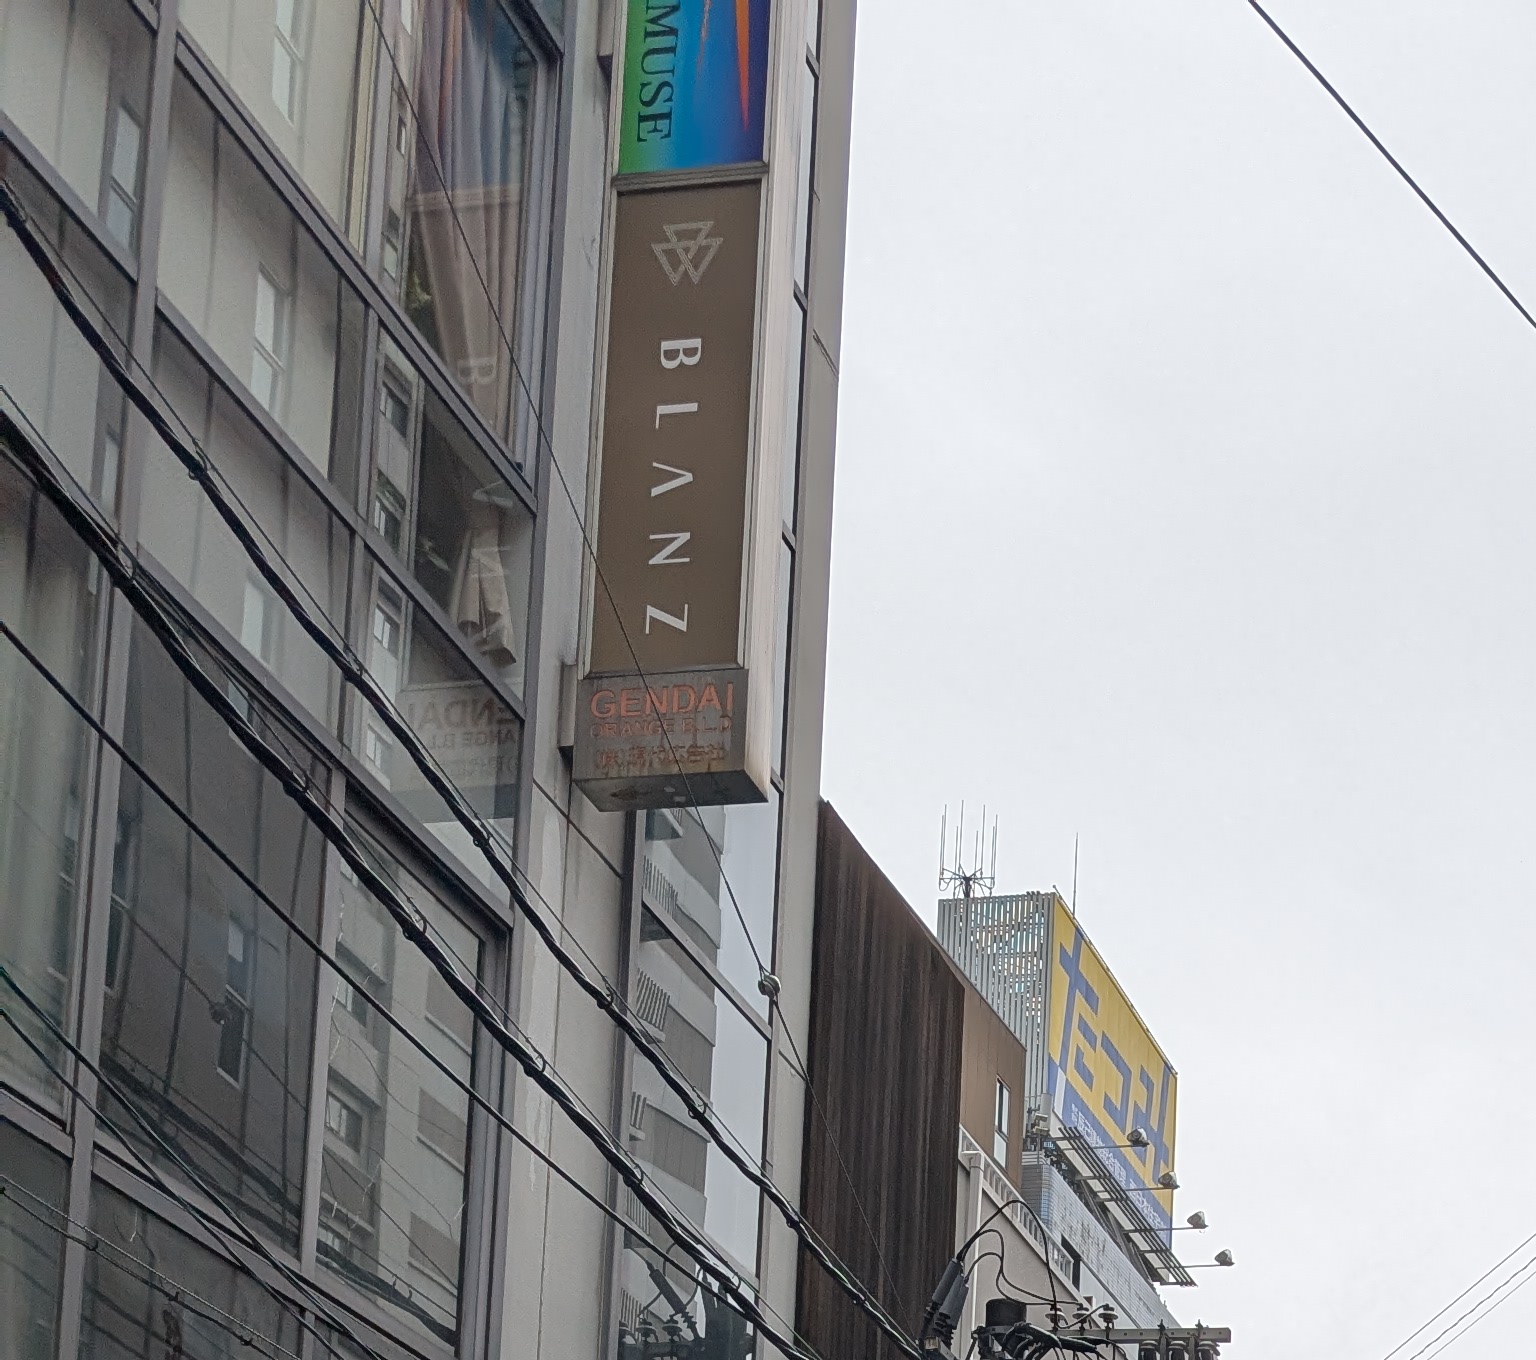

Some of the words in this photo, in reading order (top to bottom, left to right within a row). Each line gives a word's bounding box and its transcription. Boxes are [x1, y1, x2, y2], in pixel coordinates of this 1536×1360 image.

[645, 337, 702, 635] BLANZ
[591, 681, 734, 718] GENDAI
[1059, 928, 1170, 1187] たつみ
